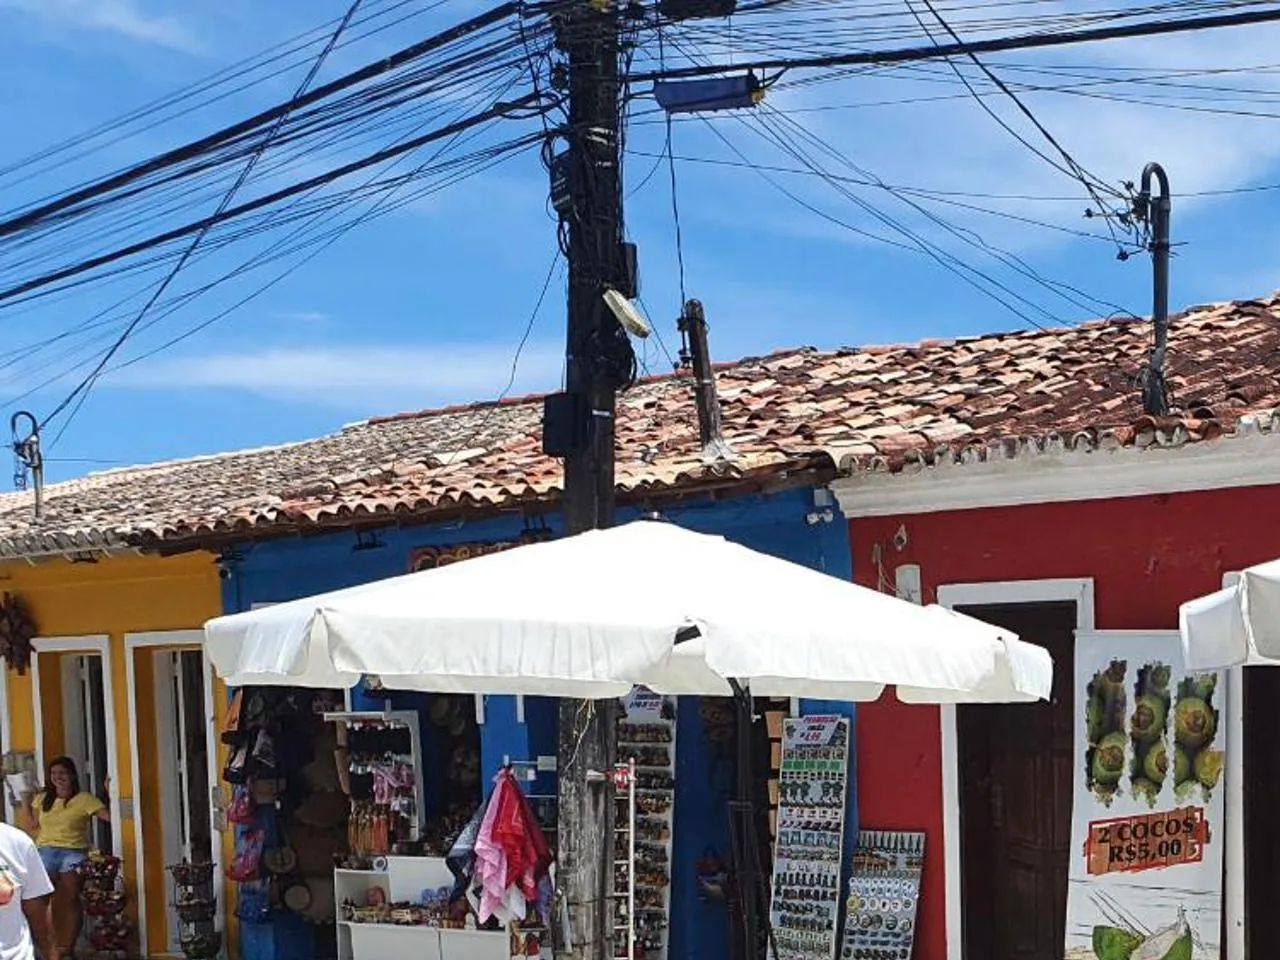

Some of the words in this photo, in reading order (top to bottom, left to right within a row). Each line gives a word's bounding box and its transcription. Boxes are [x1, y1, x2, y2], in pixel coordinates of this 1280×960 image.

[1098, 828, 1111, 843] 2
[1118, 818, 1194, 841] COCOS
[1110, 840, 1181, 862] R$5,00
